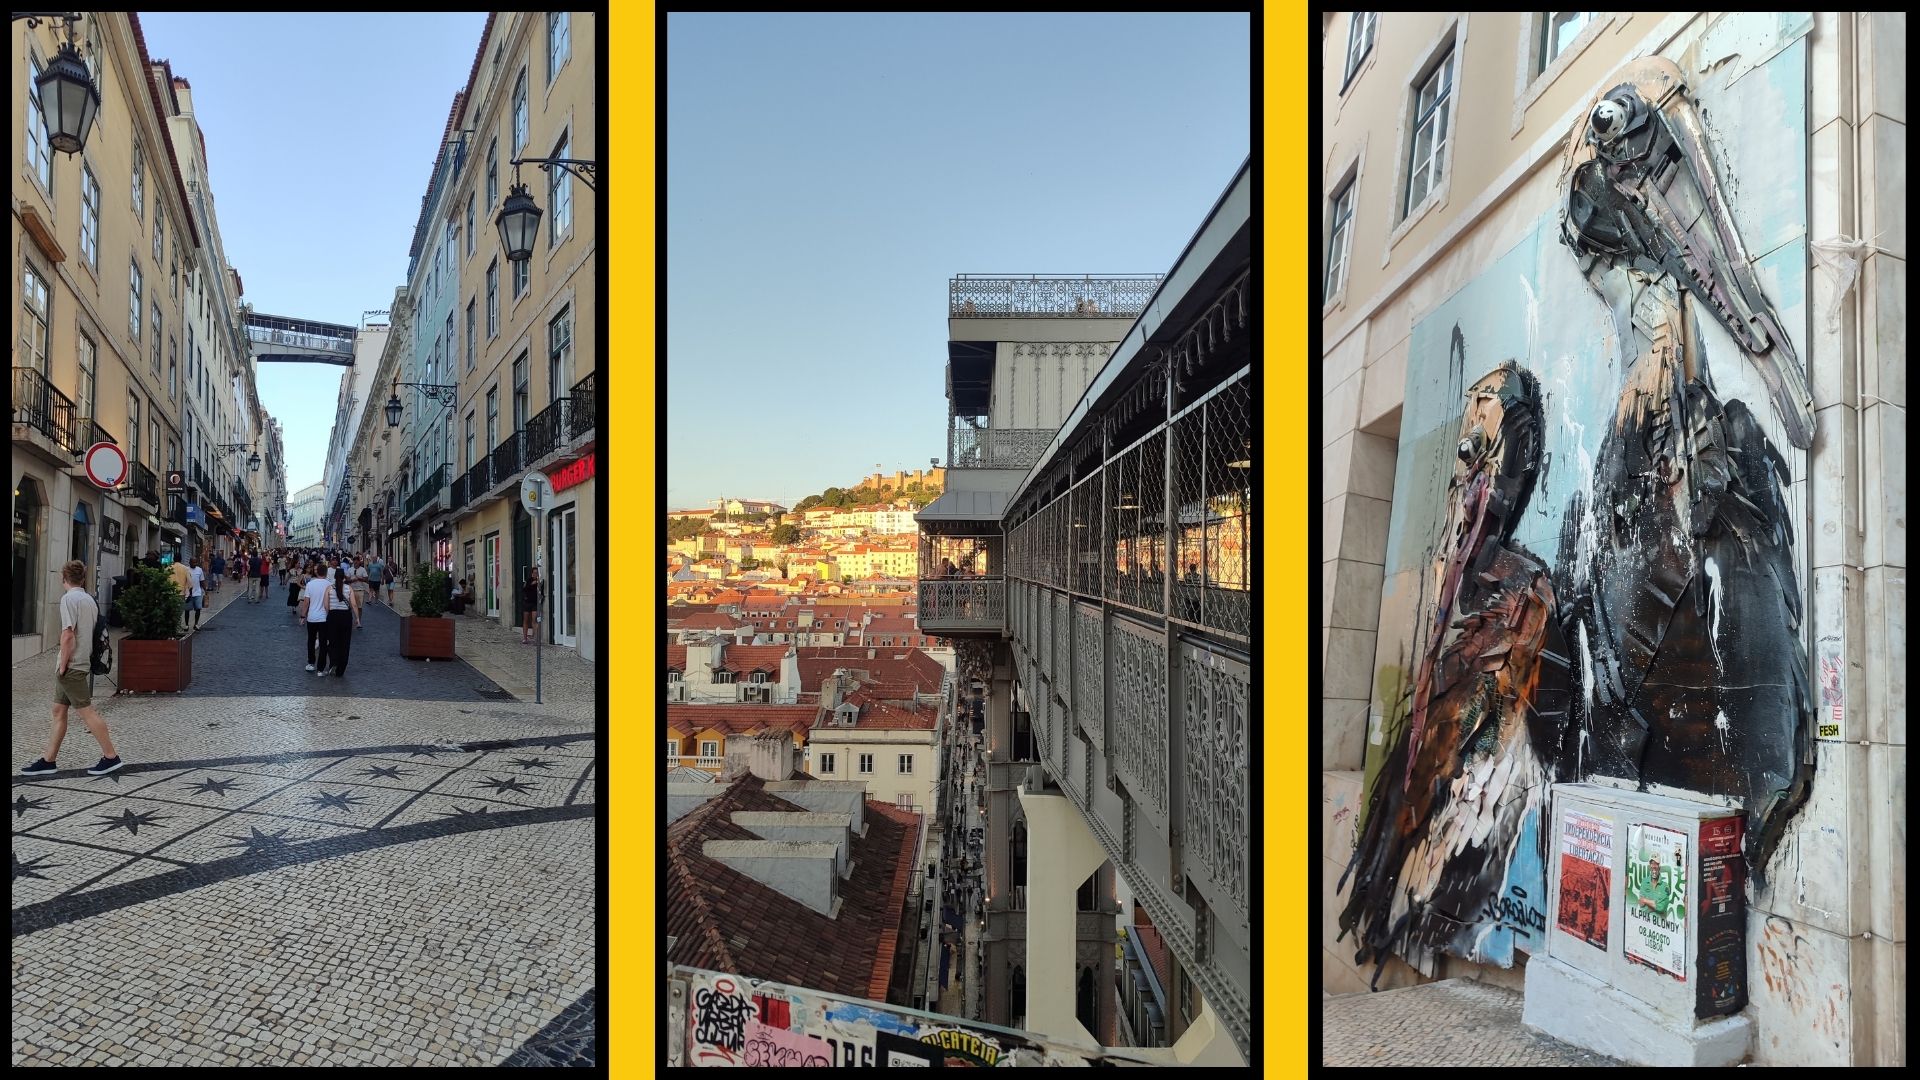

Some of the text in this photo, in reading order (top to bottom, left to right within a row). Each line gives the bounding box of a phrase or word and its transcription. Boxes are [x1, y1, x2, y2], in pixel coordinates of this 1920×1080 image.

[551, 460, 585, 491] BURGER
[1820, 724, 1839, 737] FESH
[1631, 907, 1680, 935] ALPHA BLONDY
[1645, 937, 1664, 953] LISBOA
